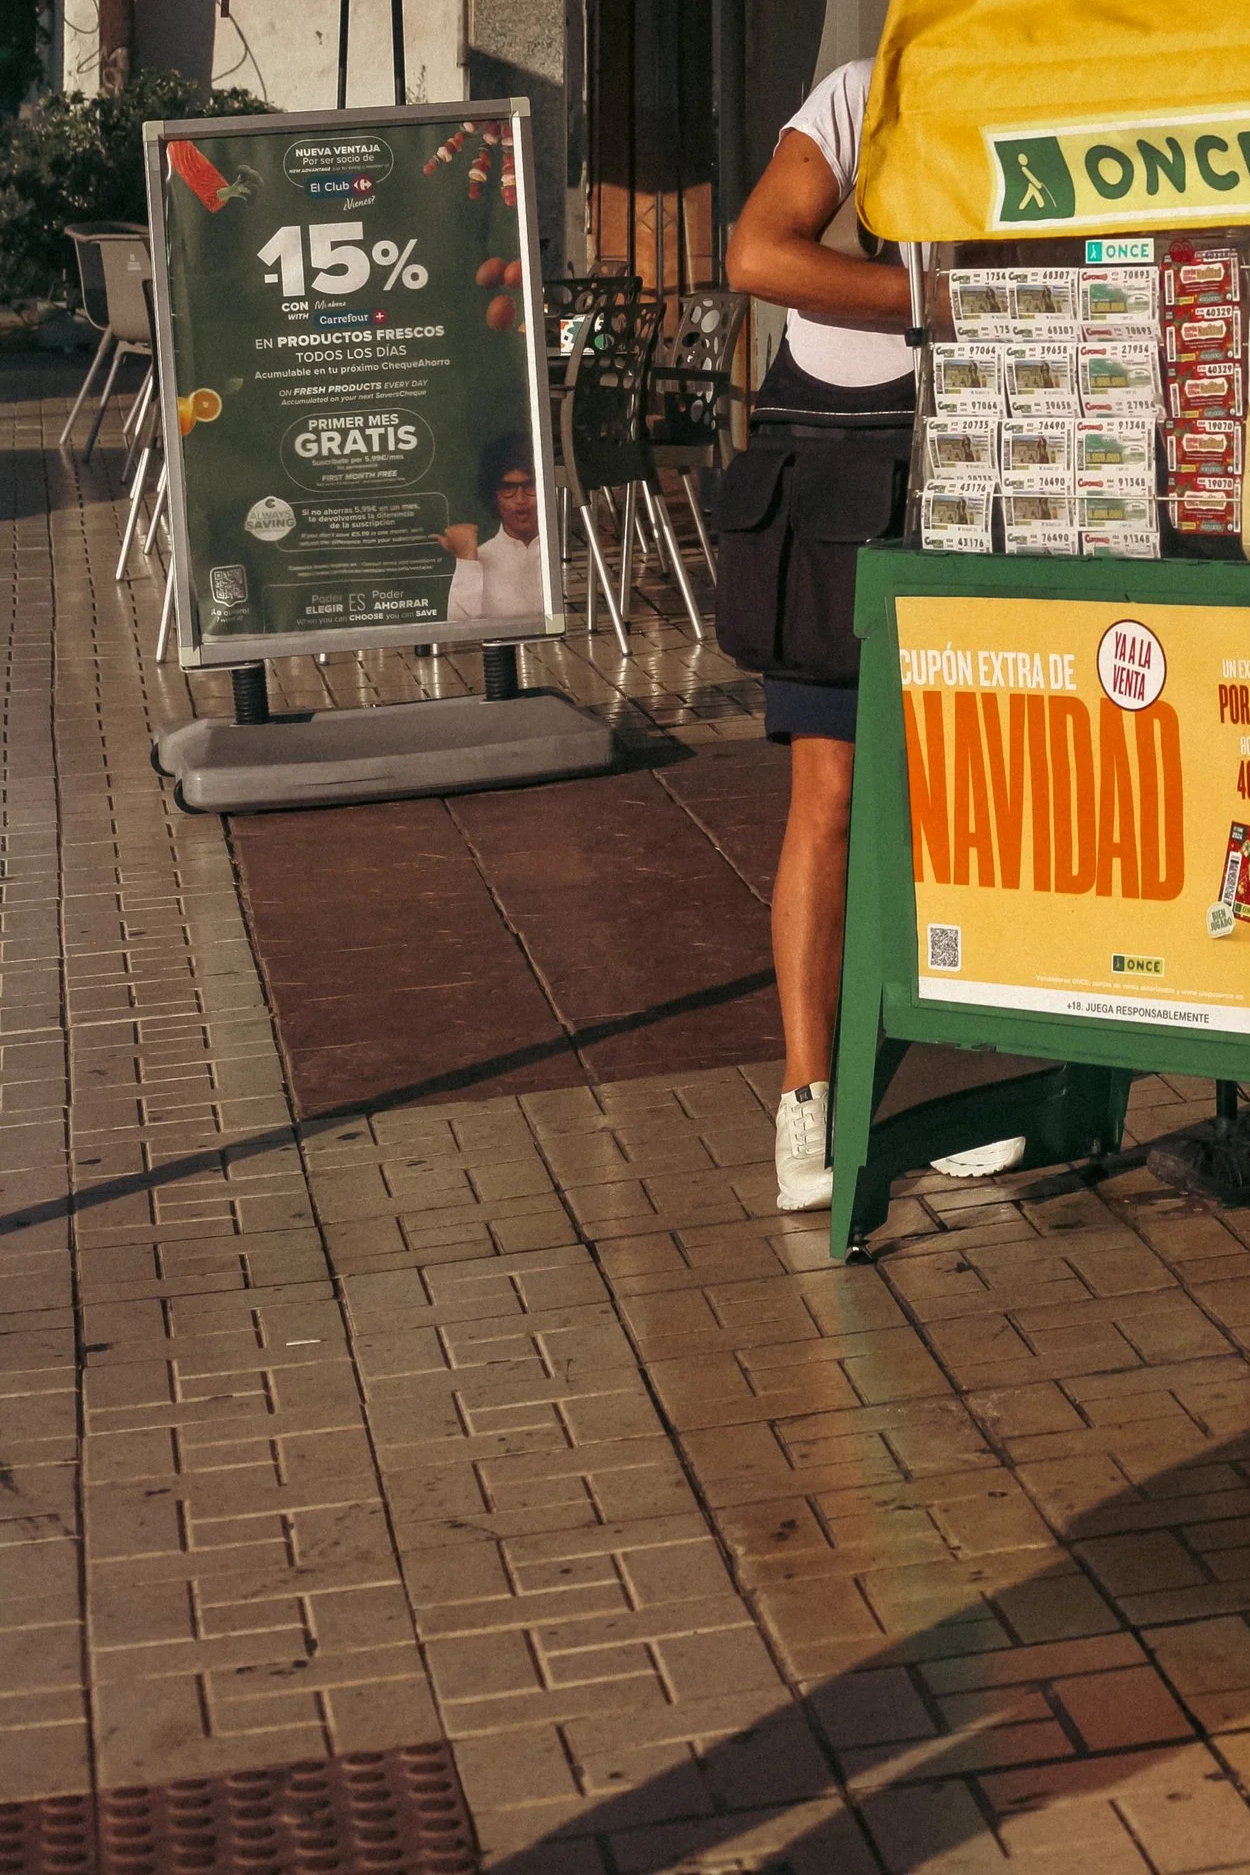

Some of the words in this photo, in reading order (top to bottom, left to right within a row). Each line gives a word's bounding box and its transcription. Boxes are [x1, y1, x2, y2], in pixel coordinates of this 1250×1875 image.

[295, 147, 331, 158] NUEVA
[333, 144, 381, 155] VENTAJA
[302, 156, 318, 166] Por
[320, 157, 334, 165] ser
[336, 155, 360, 165] socio
[363, 154, 375, 163] de
[310, 183, 321, 193] El
[325, 181, 350, 192] Club
[343, 195, 376, 211] ¿Vienes?
[1106, 243, 1150, 258] ONCE
[1042, 270, 1070, 280] 68307
[1123, 270, 1150, 280] 70893
[281, 301, 309, 312] CON
[1206, 307, 1232, 317] 40329
[288, 312, 309, 321] WITH
[319, 313, 369, 325] Carrefour
[1047, 326, 1074, 335] 68307
[255, 338, 273, 350] EN
[277, 330, 373, 348] PRODUCTOS
[376, 325, 446, 340] FRESCOS
[296, 349, 343, 363] TODOS
[347, 347, 373, 360] LOS
[376, 343, 407, 358] DÍAS
[969, 346, 996, 355] 97064
[1040, 345, 1068, 355] 39658
[1121, 344, 1149, 354] 27954
[255, 365, 312, 380] Acumulable
[314, 367, 326, 376] en
[328, 366, 338, 375] tu
[340, 361, 380, 376] próximo
[381, 357, 451, 371] ChequeAhorro
[1207, 365, 1233, 375] 40329
[279, 389, 293, 398] ON
[293, 386, 326, 396] FRESH
[328, 381, 383, 394] PRODUCTS
[383, 380, 410, 390] EVERY
[411, 378, 429, 388] DAY
[281, 395, 329, 406] Accumulated
[340, 394, 358, 404] your
[971, 401, 998, 410] 97064
[1045, 401, 1072, 410] 39658
[1127, 401, 1156, 411] 27954
[308, 416, 365, 430] PRIMER
[368, 413, 399, 427] MES
[962, 420, 989, 429] 20735
[1038, 421, 1066, 430] 76490
[1118, 420, 1146, 430] 91348
[1207, 421, 1233, 431] 19070
[294, 425, 418, 458] GRATIS
[322, 473, 344, 482] FIRST
[344, 471, 376, 481] MONTH
[377, 469, 398, 478] FREE
[959, 483, 987, 493] 43176
[1039, 477, 1066, 487] 76490
[1118, 477, 1146, 487] 91348
[1207, 479, 1233, 489] 19070
[250, 510, 292, 520] ALWAYS
[301, 508, 310, 516] Si
[311, 508, 322, 516] no
[323, 506, 353, 516] ahorras
[246, 518, 295, 530] SAVING
[318, 513, 367, 523] devolvemos
[342, 521, 350, 529] la
[957, 537, 985, 548] 43176
[1041, 533, 1070, 543] 76490
[1123, 534, 1150, 544] 91348
[311, 593, 343, 604] Poder
[349, 592, 366, 612] ES
[372, 589, 405, 600] Poder
[305, 604, 344, 615] ELEGIR
[373, 599, 429, 610] AHORRAR
[297, 616, 318, 626] When
[319, 616, 333, 626] you
[334, 615, 348, 624] can
[349, 612, 384, 622] CHOOSE
[385, 613, 400, 621] you
[401, 611, 415, 620] can
[415, 608, 437, 618] SAVE
[1115, 631, 1127, 662] YA
[1128, 636, 1136, 665] A
[1138, 637, 1151, 670] LA
[900, 641, 973, 686] CUPÓN
[978, 651, 1045, 689] EXTRA
[1050, 654, 1077, 690] DE
[1222, 659, 1236, 679] UN
[1112, 663, 1145, 702] VENTA
[1218, 684, 1250, 726] POR
[902, 690, 1185, 901] NAVIDAD
[1211, 909, 1226, 921] BIEN
[1210, 917, 1233, 932] JUGADO
[1127, 959, 1161, 973] ONCE
[1085, 1002, 1114, 1014] JUEGA
[1116, 1005, 1210, 1024] RESPONSABLEMENTE
